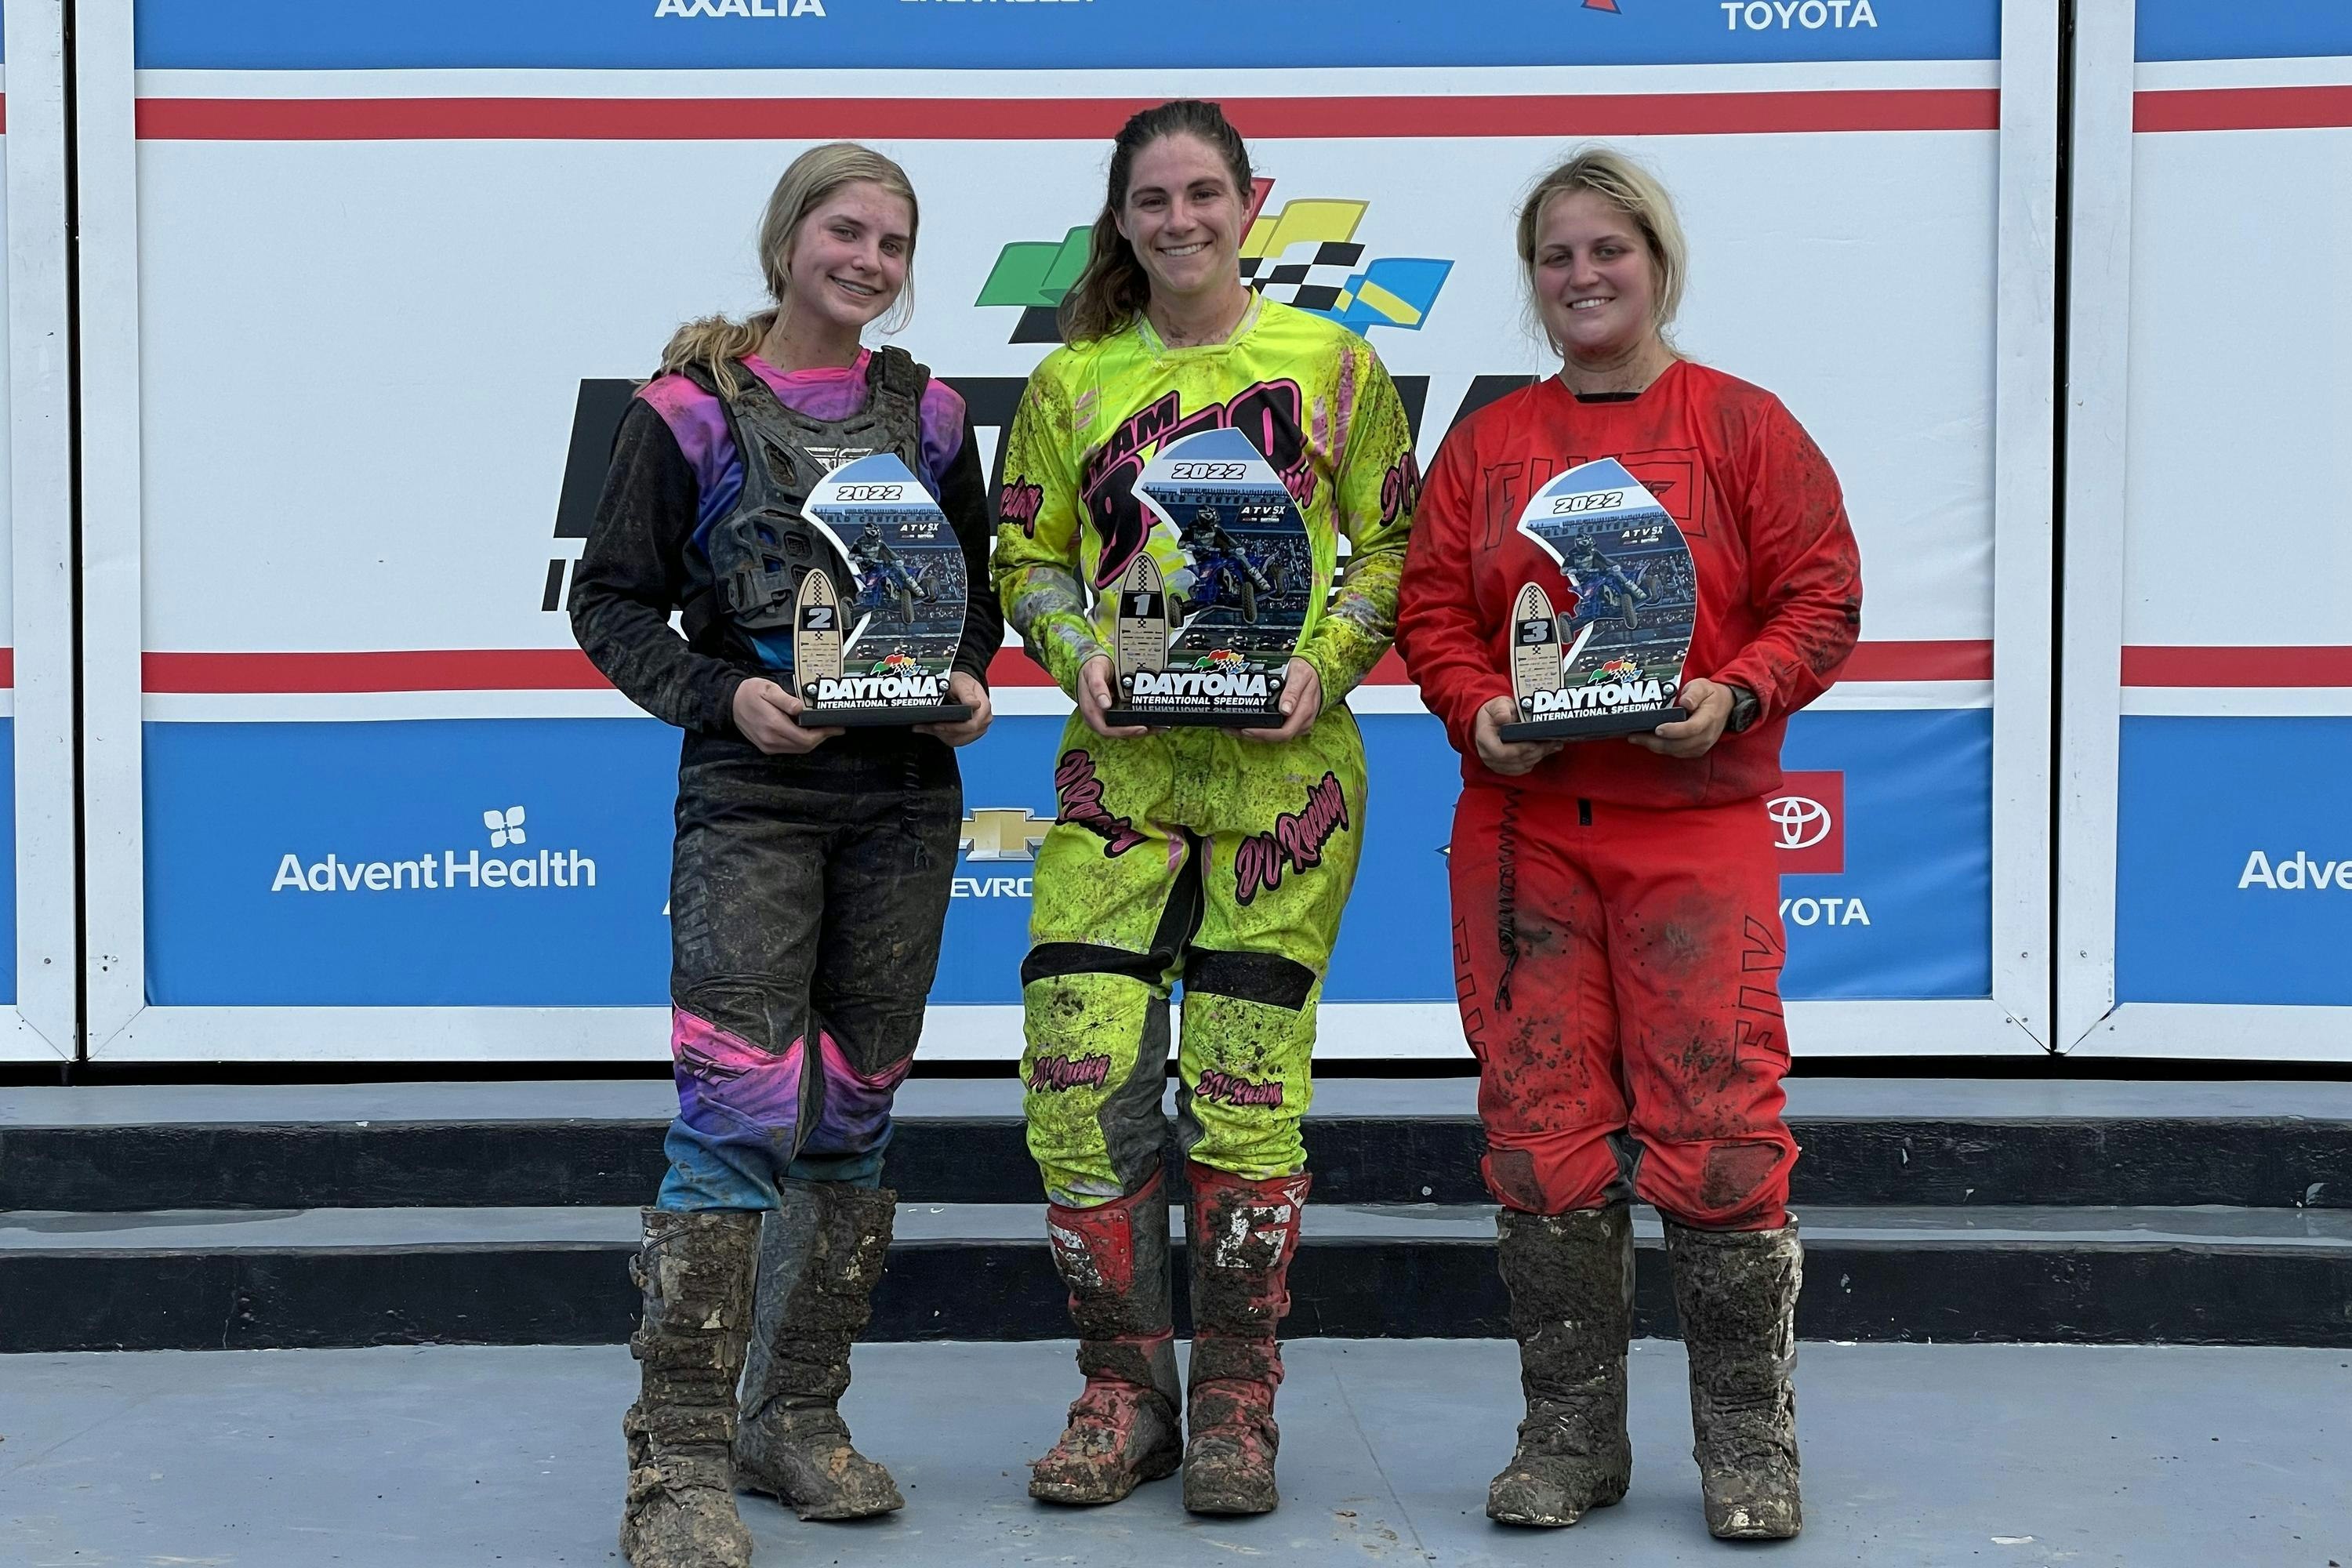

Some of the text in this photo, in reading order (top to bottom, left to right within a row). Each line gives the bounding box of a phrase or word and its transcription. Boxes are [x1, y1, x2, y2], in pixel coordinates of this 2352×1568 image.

[1721, 0, 1877, 30] TOYOTA
[1171, 463, 1247, 480] 2022
[836, 485, 903, 502] 2022
[1553, 492, 1623, 514] 2022
[1133, 594, 1151, 615] 1
[807, 608, 832, 628] 2
[1523, 621, 1548, 643] 3
[818, 677, 938, 700] DAYTONA
[1133, 673, 1267, 696] DAYTONA
[818, 698, 938, 709] INTERNATIONAL SPEEDWAY
[1131, 696, 1268, 706] INTERNATIONAL SPEEDWAY
[1533, 680, 1662, 713] DAYTONA
[1533, 702, 1663, 721] INTERNATIONAL SPEEDWAY
